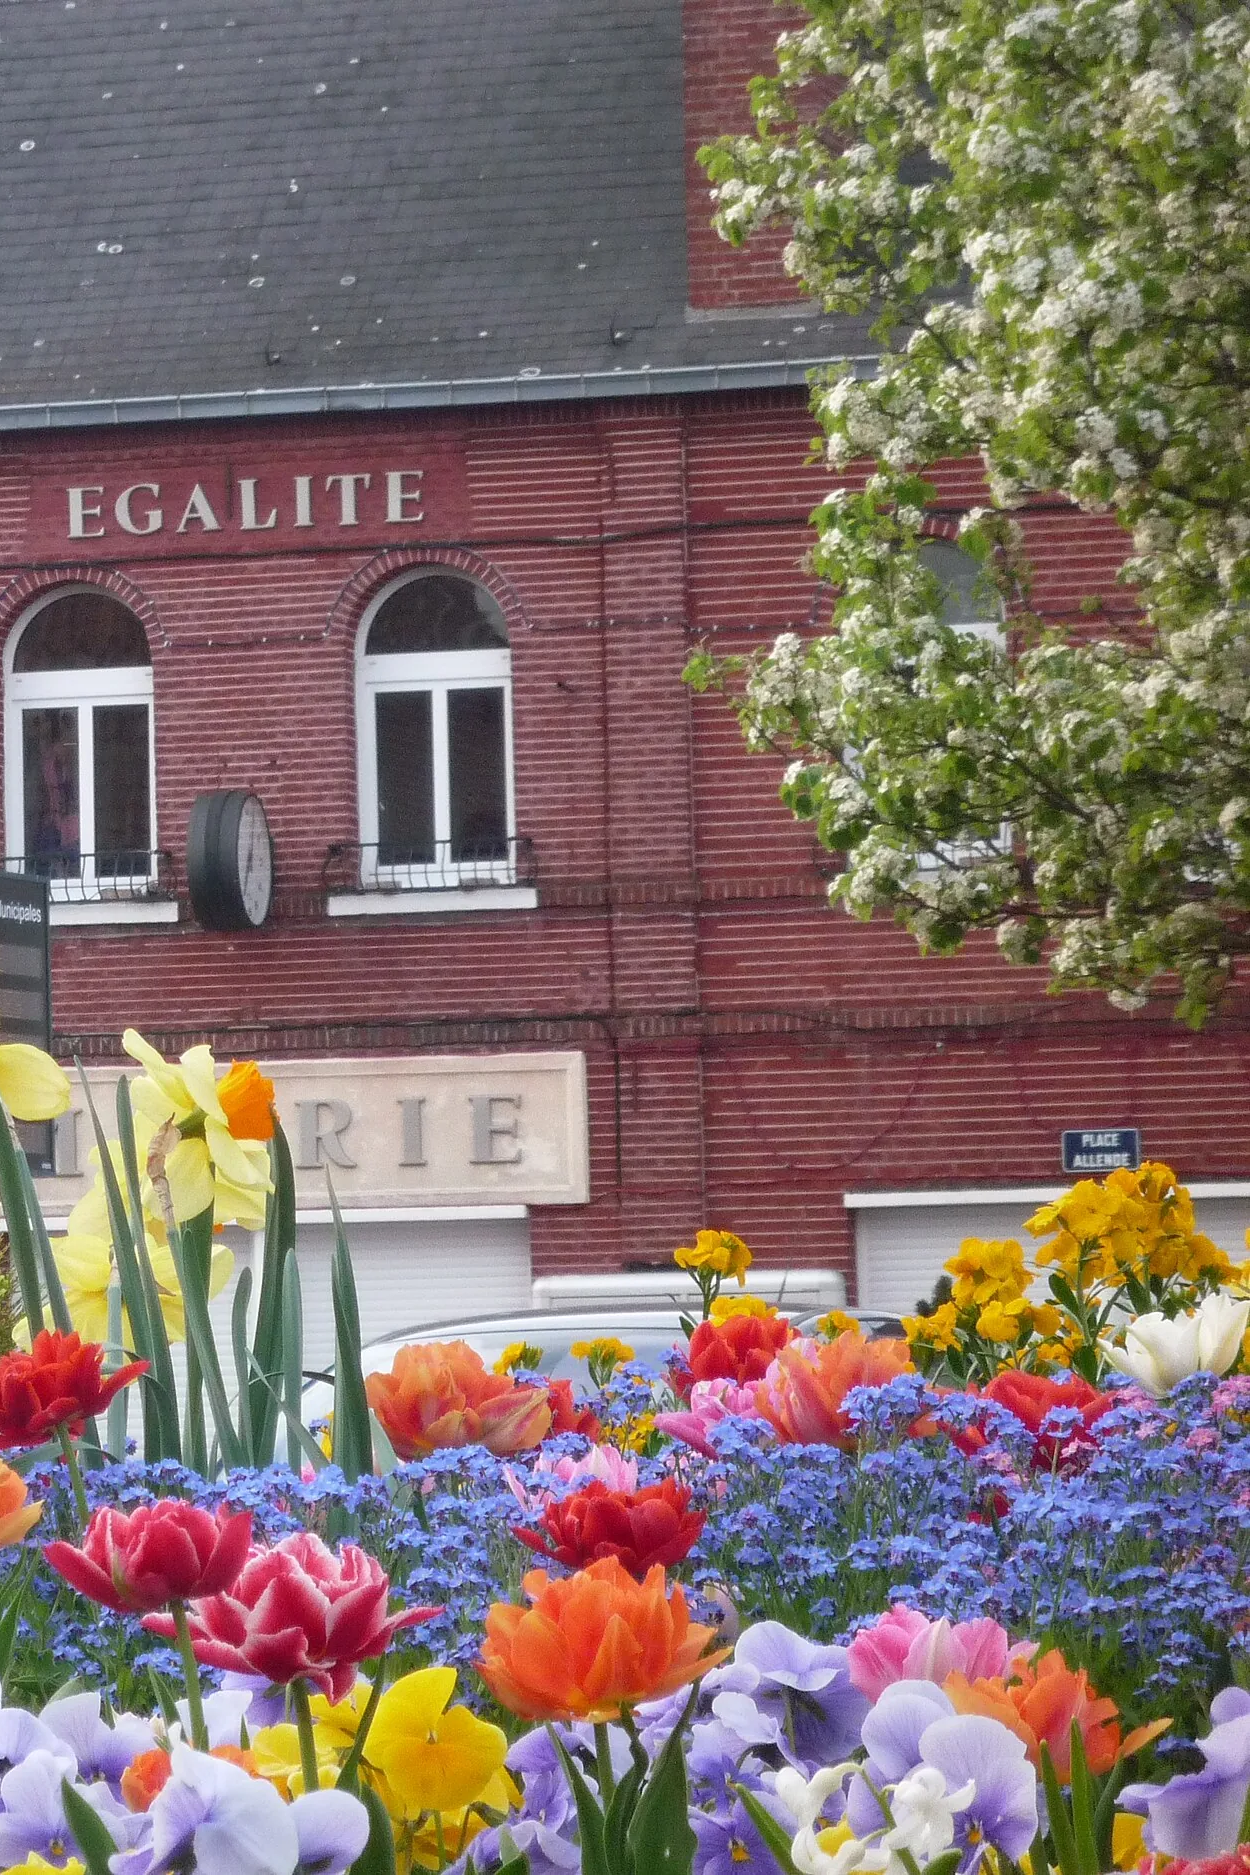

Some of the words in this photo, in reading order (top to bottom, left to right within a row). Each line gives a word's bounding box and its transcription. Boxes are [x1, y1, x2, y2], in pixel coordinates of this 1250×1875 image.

[66, 470, 425, 540] EGALITE
[1081, 1133, 1121, 1148] PLACE
[1073, 1153, 1131, 1168] ALLENDE
